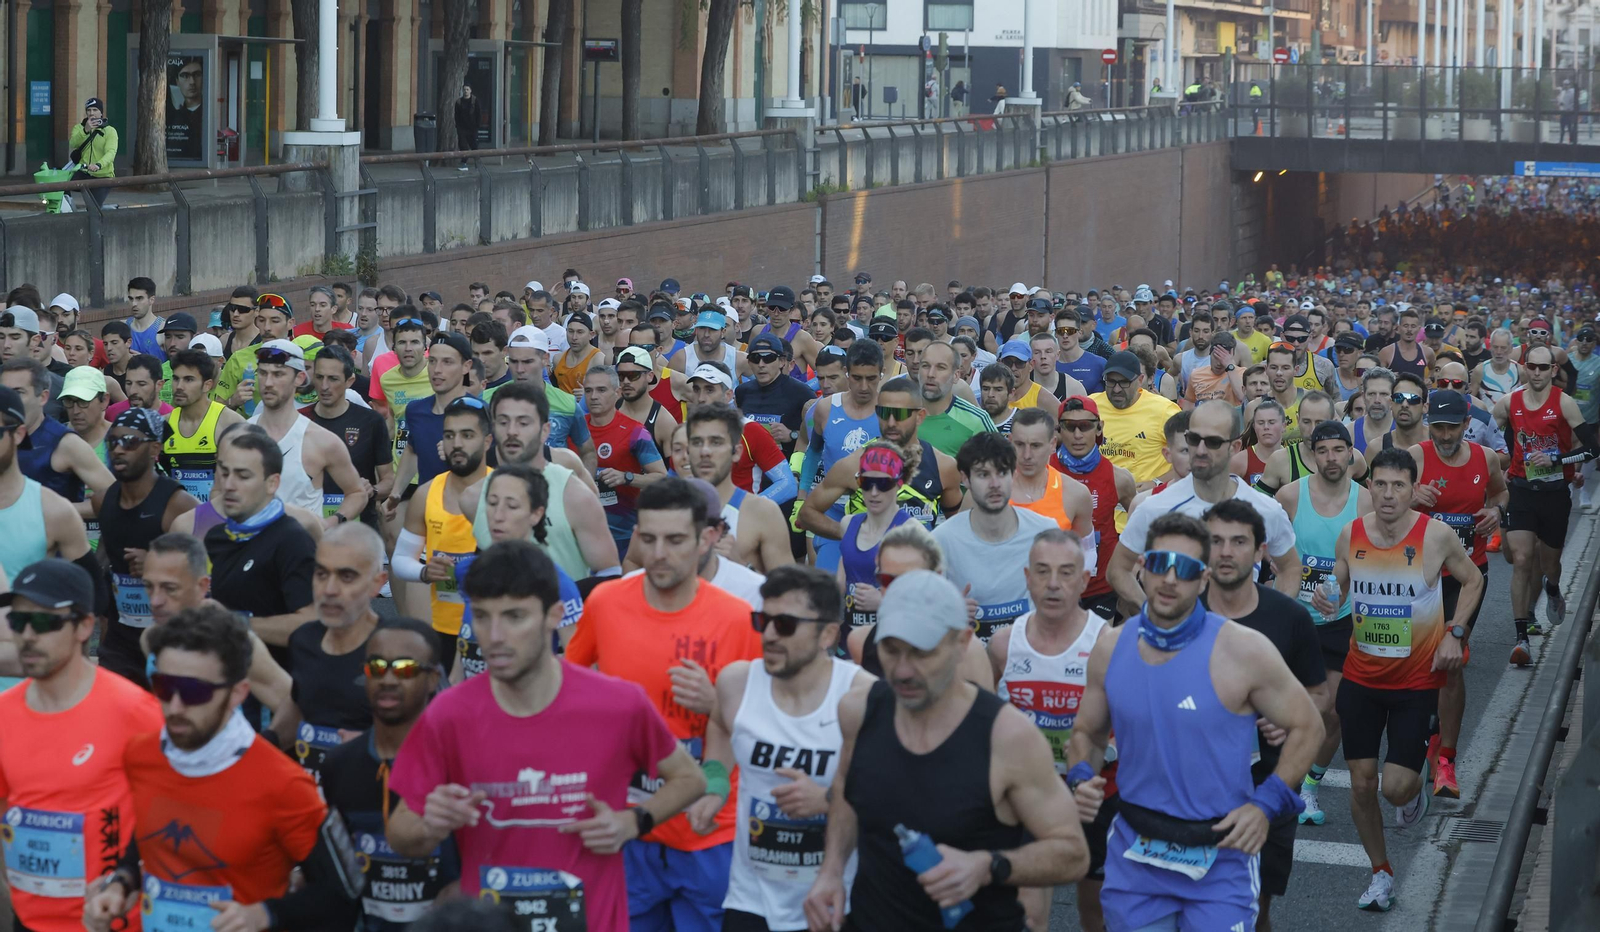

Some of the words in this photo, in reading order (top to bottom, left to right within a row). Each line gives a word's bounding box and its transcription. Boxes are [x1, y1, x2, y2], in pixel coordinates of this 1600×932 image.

[866, 452, 896, 468] VAGA
[1353, 580, 1416, 597] TOBARRA
[988, 603, 1023, 616] ZURICH
[1372, 607, 1404, 616] ZURICH
[1365, 631, 1400, 644] HUEDO
[1065, 667, 1084, 675] MC
[751, 741, 836, 776] BEAT
[25, 812, 73, 829] ZURICH
[777, 831, 804, 844] 3717
[18, 852, 60, 875] RÉMY
[164, 886, 220, 904] ZURICH
[371, 880, 425, 900] KENNY
